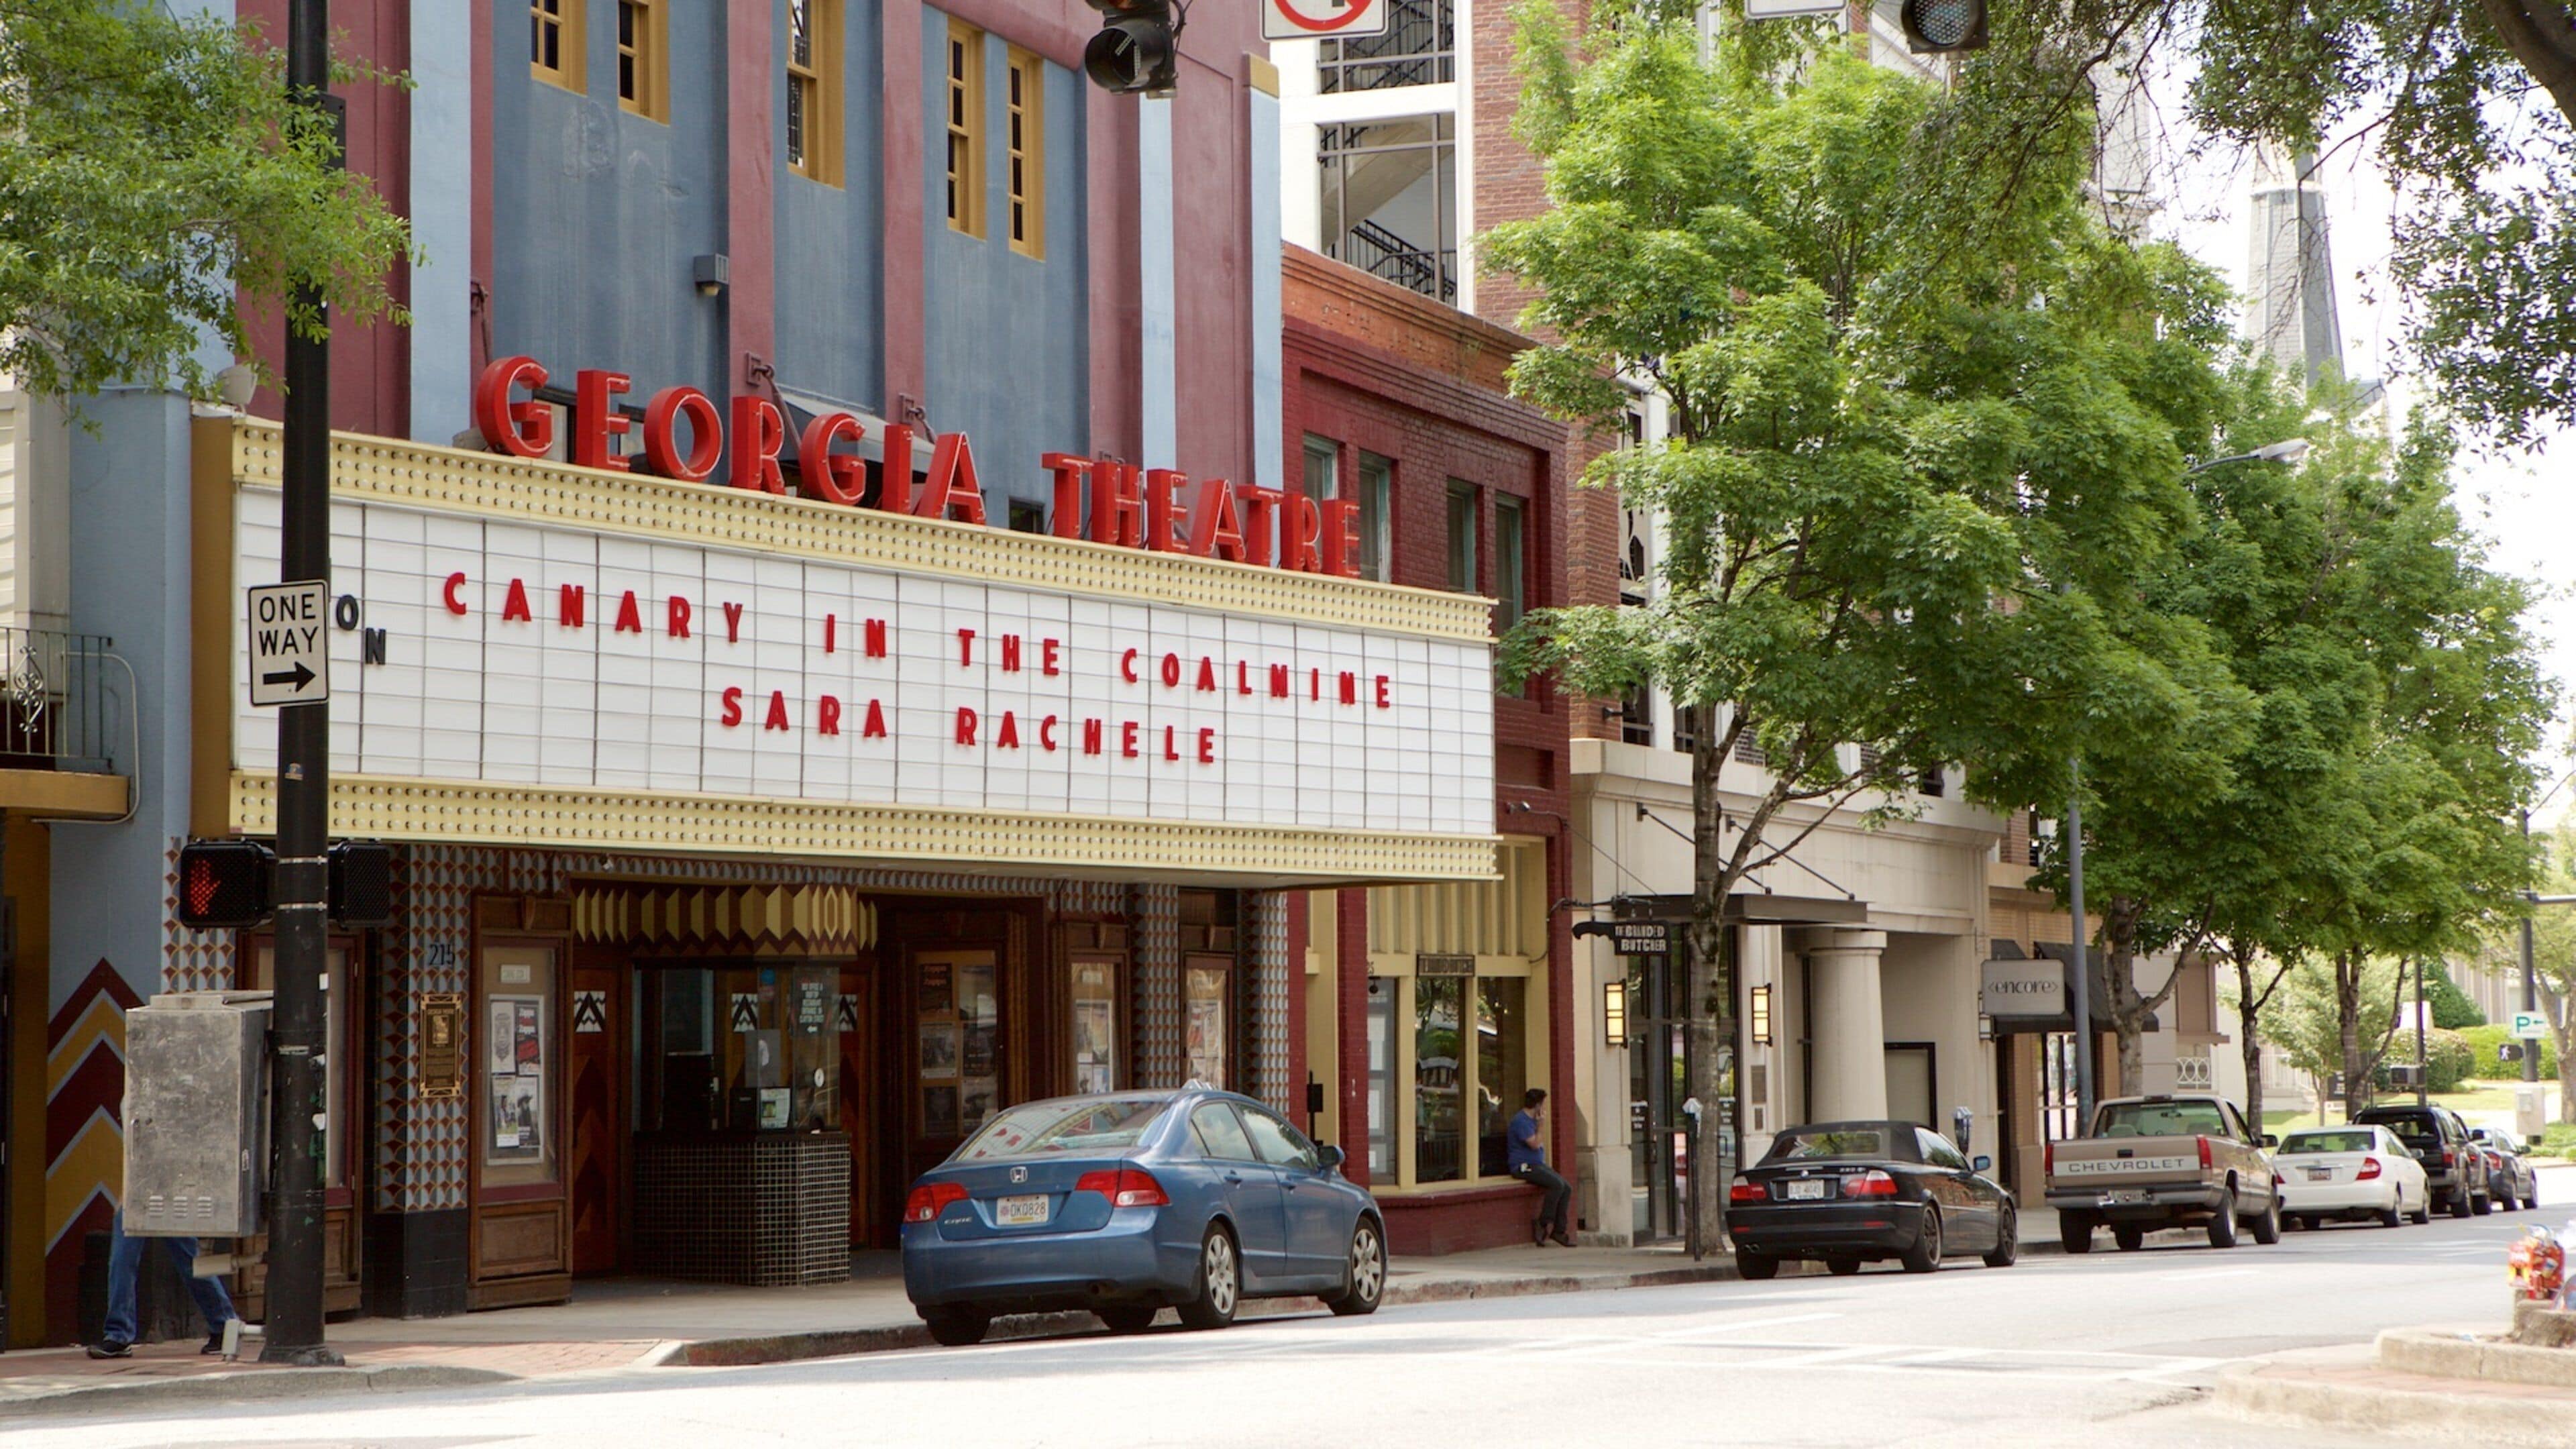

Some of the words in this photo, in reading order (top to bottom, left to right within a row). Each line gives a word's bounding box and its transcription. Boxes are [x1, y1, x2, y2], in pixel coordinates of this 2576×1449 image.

[476, 356, 985, 525] GEORGIA
[1042, 452, 1360, 578] THEATRE
[260, 593, 316, 623] ONE
[259, 626, 319, 657] WAY
[443, 572, 743, 643] CANARY
[824, 614, 887, 659] IN
[957, 629, 1059, 677] THE
[1121, 648, 1390, 709] COALMINE
[721, 686, 886, 739] SARA
[955, 707, 1214, 765] RACHELE
[429, 944, 455, 966] 215
[2516, 1016, 2530, 1033] P
[2069, 1159, 2184, 1173] CHEVROLET
